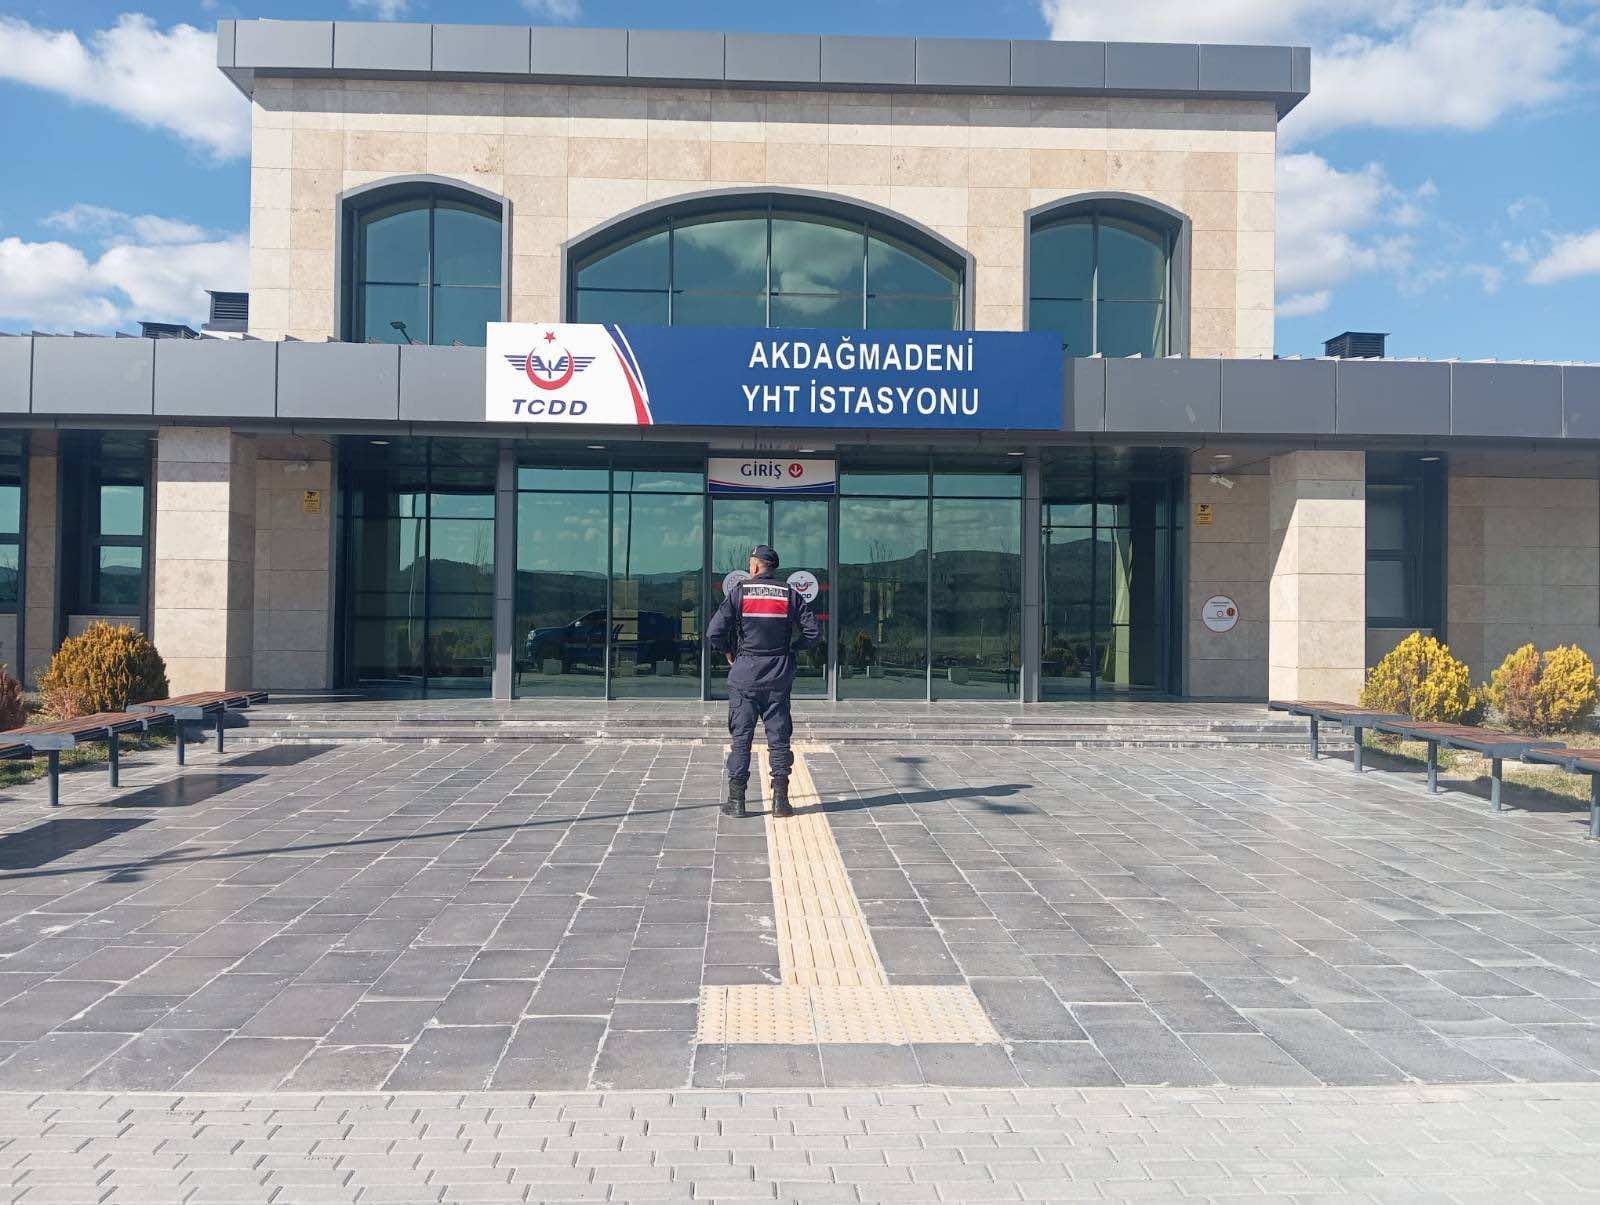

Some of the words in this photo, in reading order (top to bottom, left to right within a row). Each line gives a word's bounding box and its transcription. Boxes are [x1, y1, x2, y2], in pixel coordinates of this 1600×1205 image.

[748, 335, 974, 371] AKDAĞMADENİ
[512, 398, 588, 416] TCDD
[741, 384, 801, 413] YHT
[810, 379, 979, 415] İSTASYONU
[740, 460, 782, 480] GİRİŞ
[747, 586, 784, 597] JANDARMA
